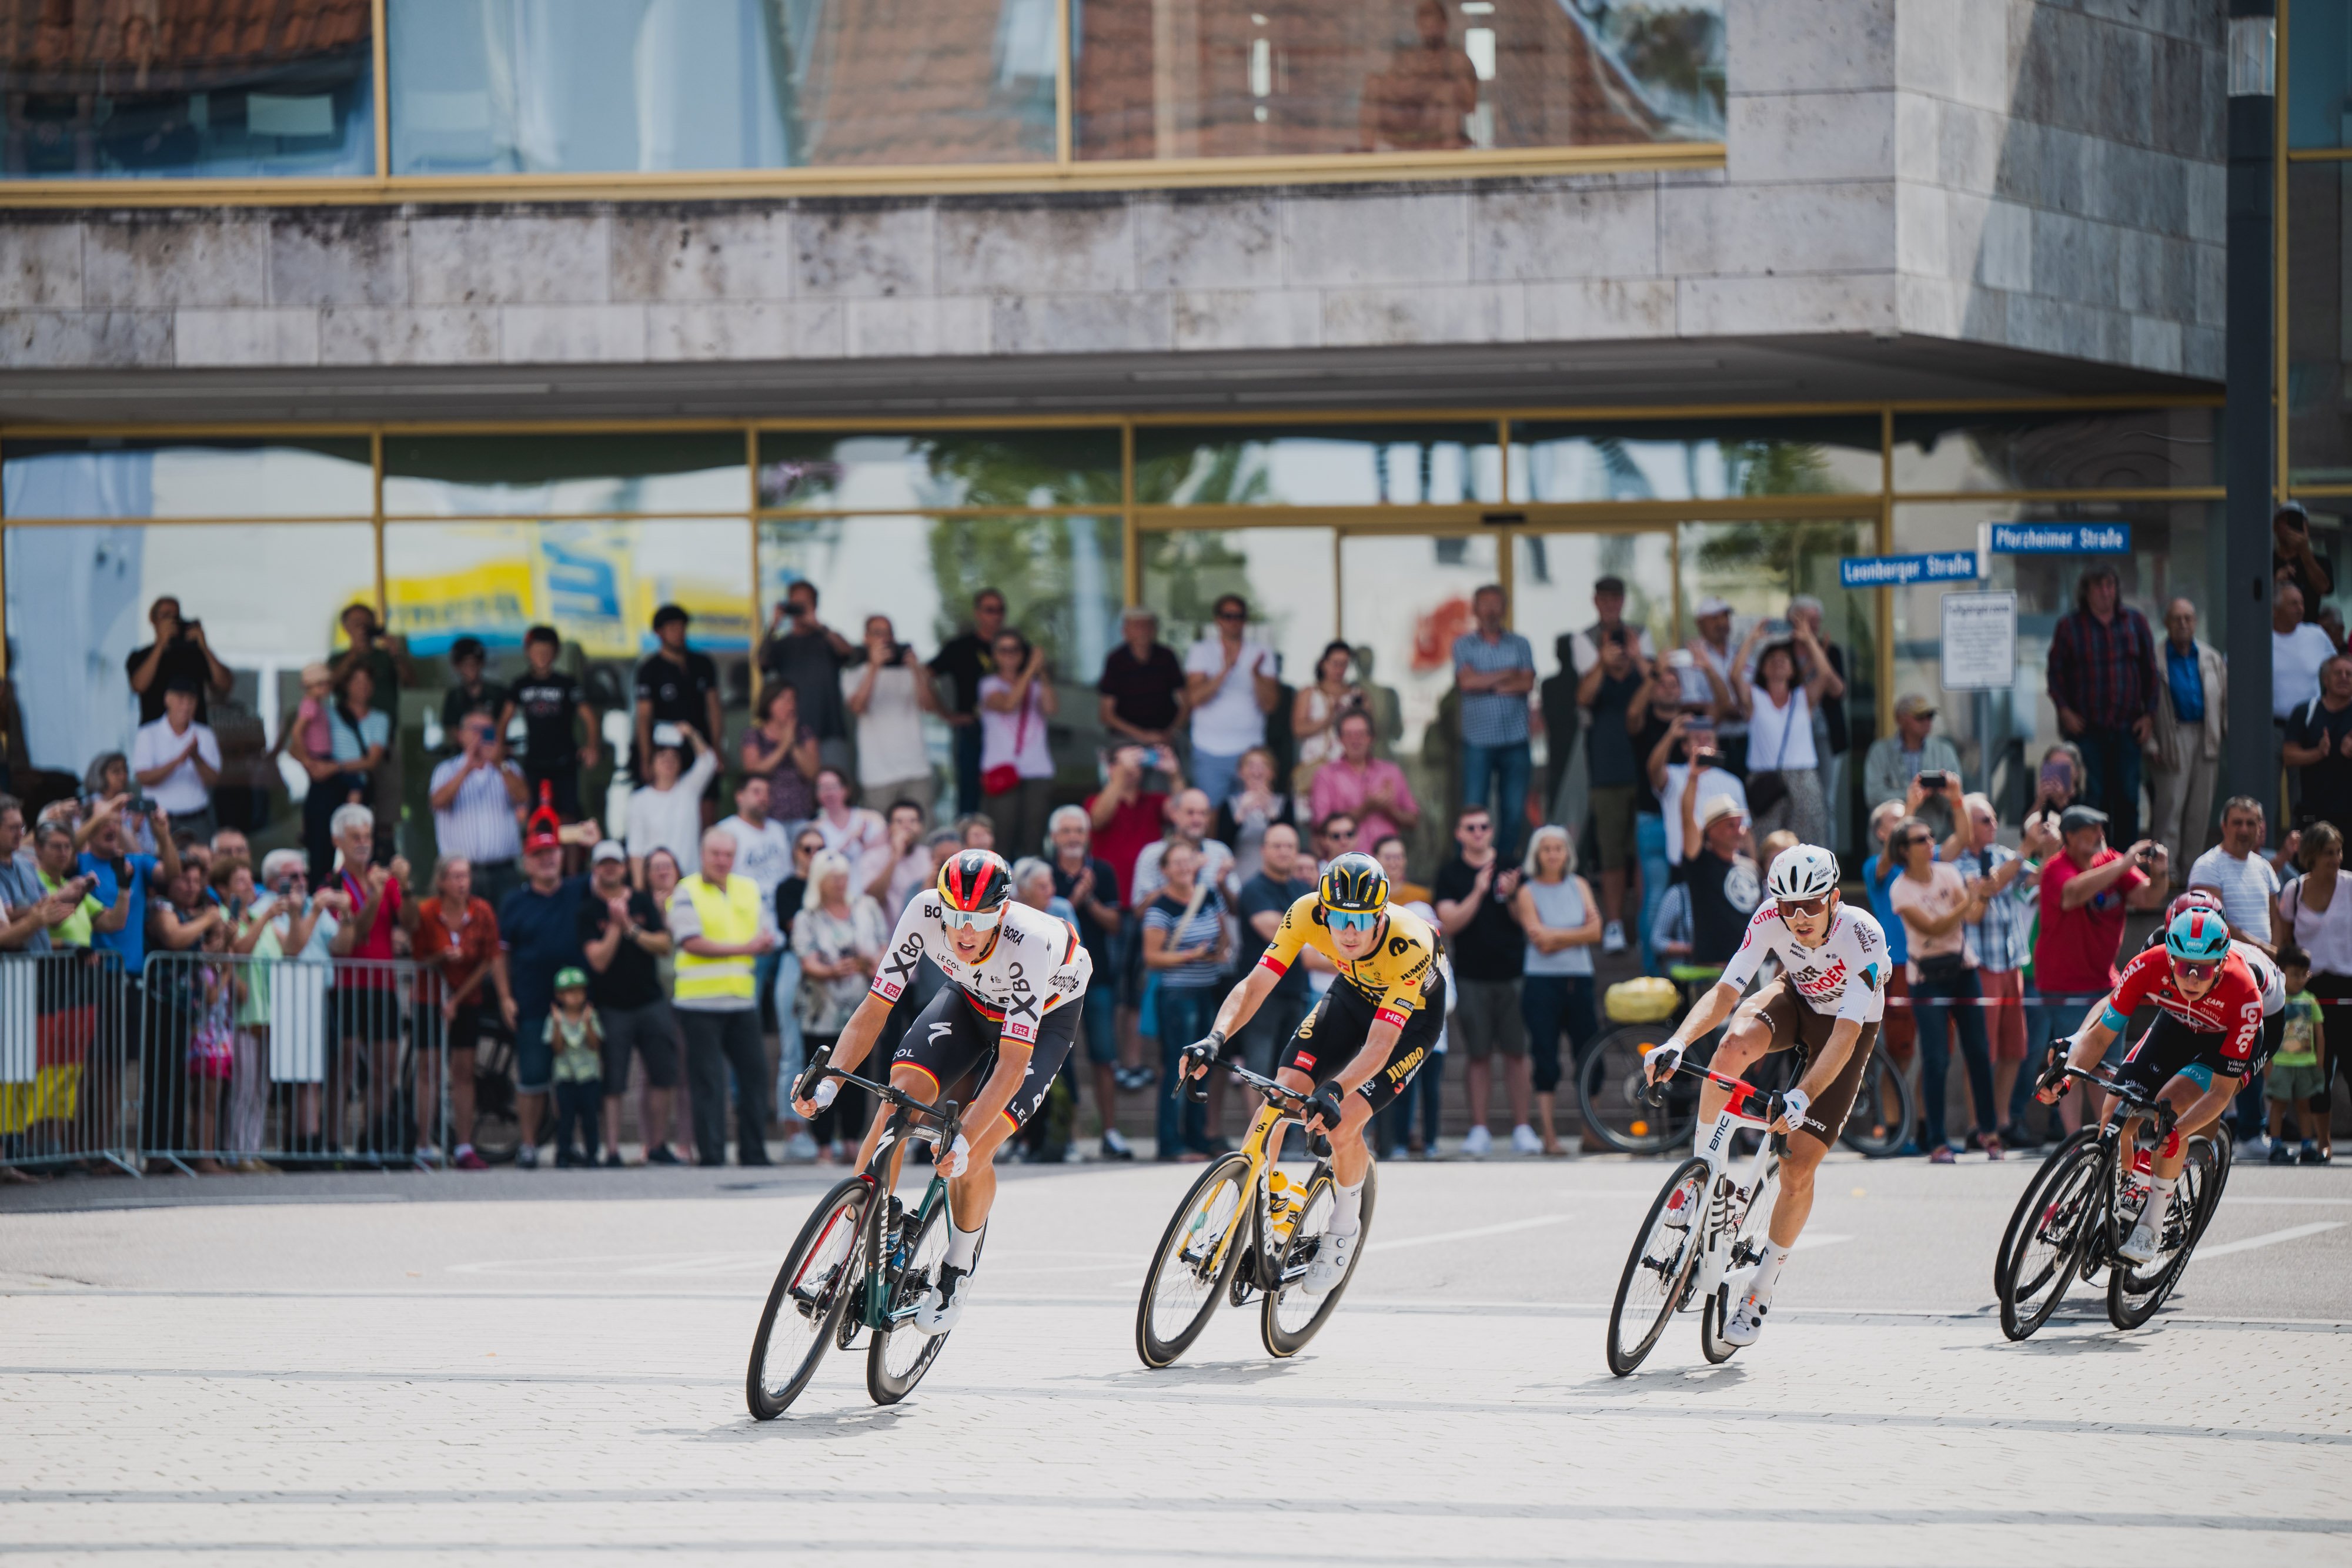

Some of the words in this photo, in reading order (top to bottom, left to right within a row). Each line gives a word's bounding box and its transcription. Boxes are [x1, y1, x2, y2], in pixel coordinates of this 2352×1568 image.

[1996, 526, 2073, 549] Pforzheimer
[2080, 526, 2123, 549] Straße
[1845, 558, 1920, 584] Leonberger
[1927, 551, 1972, 576] Straße
[1816, 870, 1831, 881] MONDIALE
[1364, 885, 1372, 902] JUMBO
[1003, 925, 1025, 946] BORA
[1853, 922, 1872, 954] MONDIALE
[1868, 933, 1877, 944] LA
[1791, 942, 1806, 954] BMC
[937, 953, 946, 963] LE
[946, 958, 961, 971] COL
[1400, 954, 1431, 981] JUMBO
[886, 989, 897, 998] TAL
[887, 984, 898, 994] ÖTZ
[2206, 997, 2225, 1008] CAPS
[2200, 1006, 2221, 1022] dstny
[1014, 1024, 1028, 1032] ÖTZ
[1297, 1056, 1312, 1066] HEMA
[1387, 1047, 1424, 1084] JUMBO
[2253, 1050, 2268, 1076] UAE
[1011, 1101, 1026, 1119] LE
[1709, 1115, 1730, 1151] BMC
[2170, 1246, 2192, 1285] SWISS
